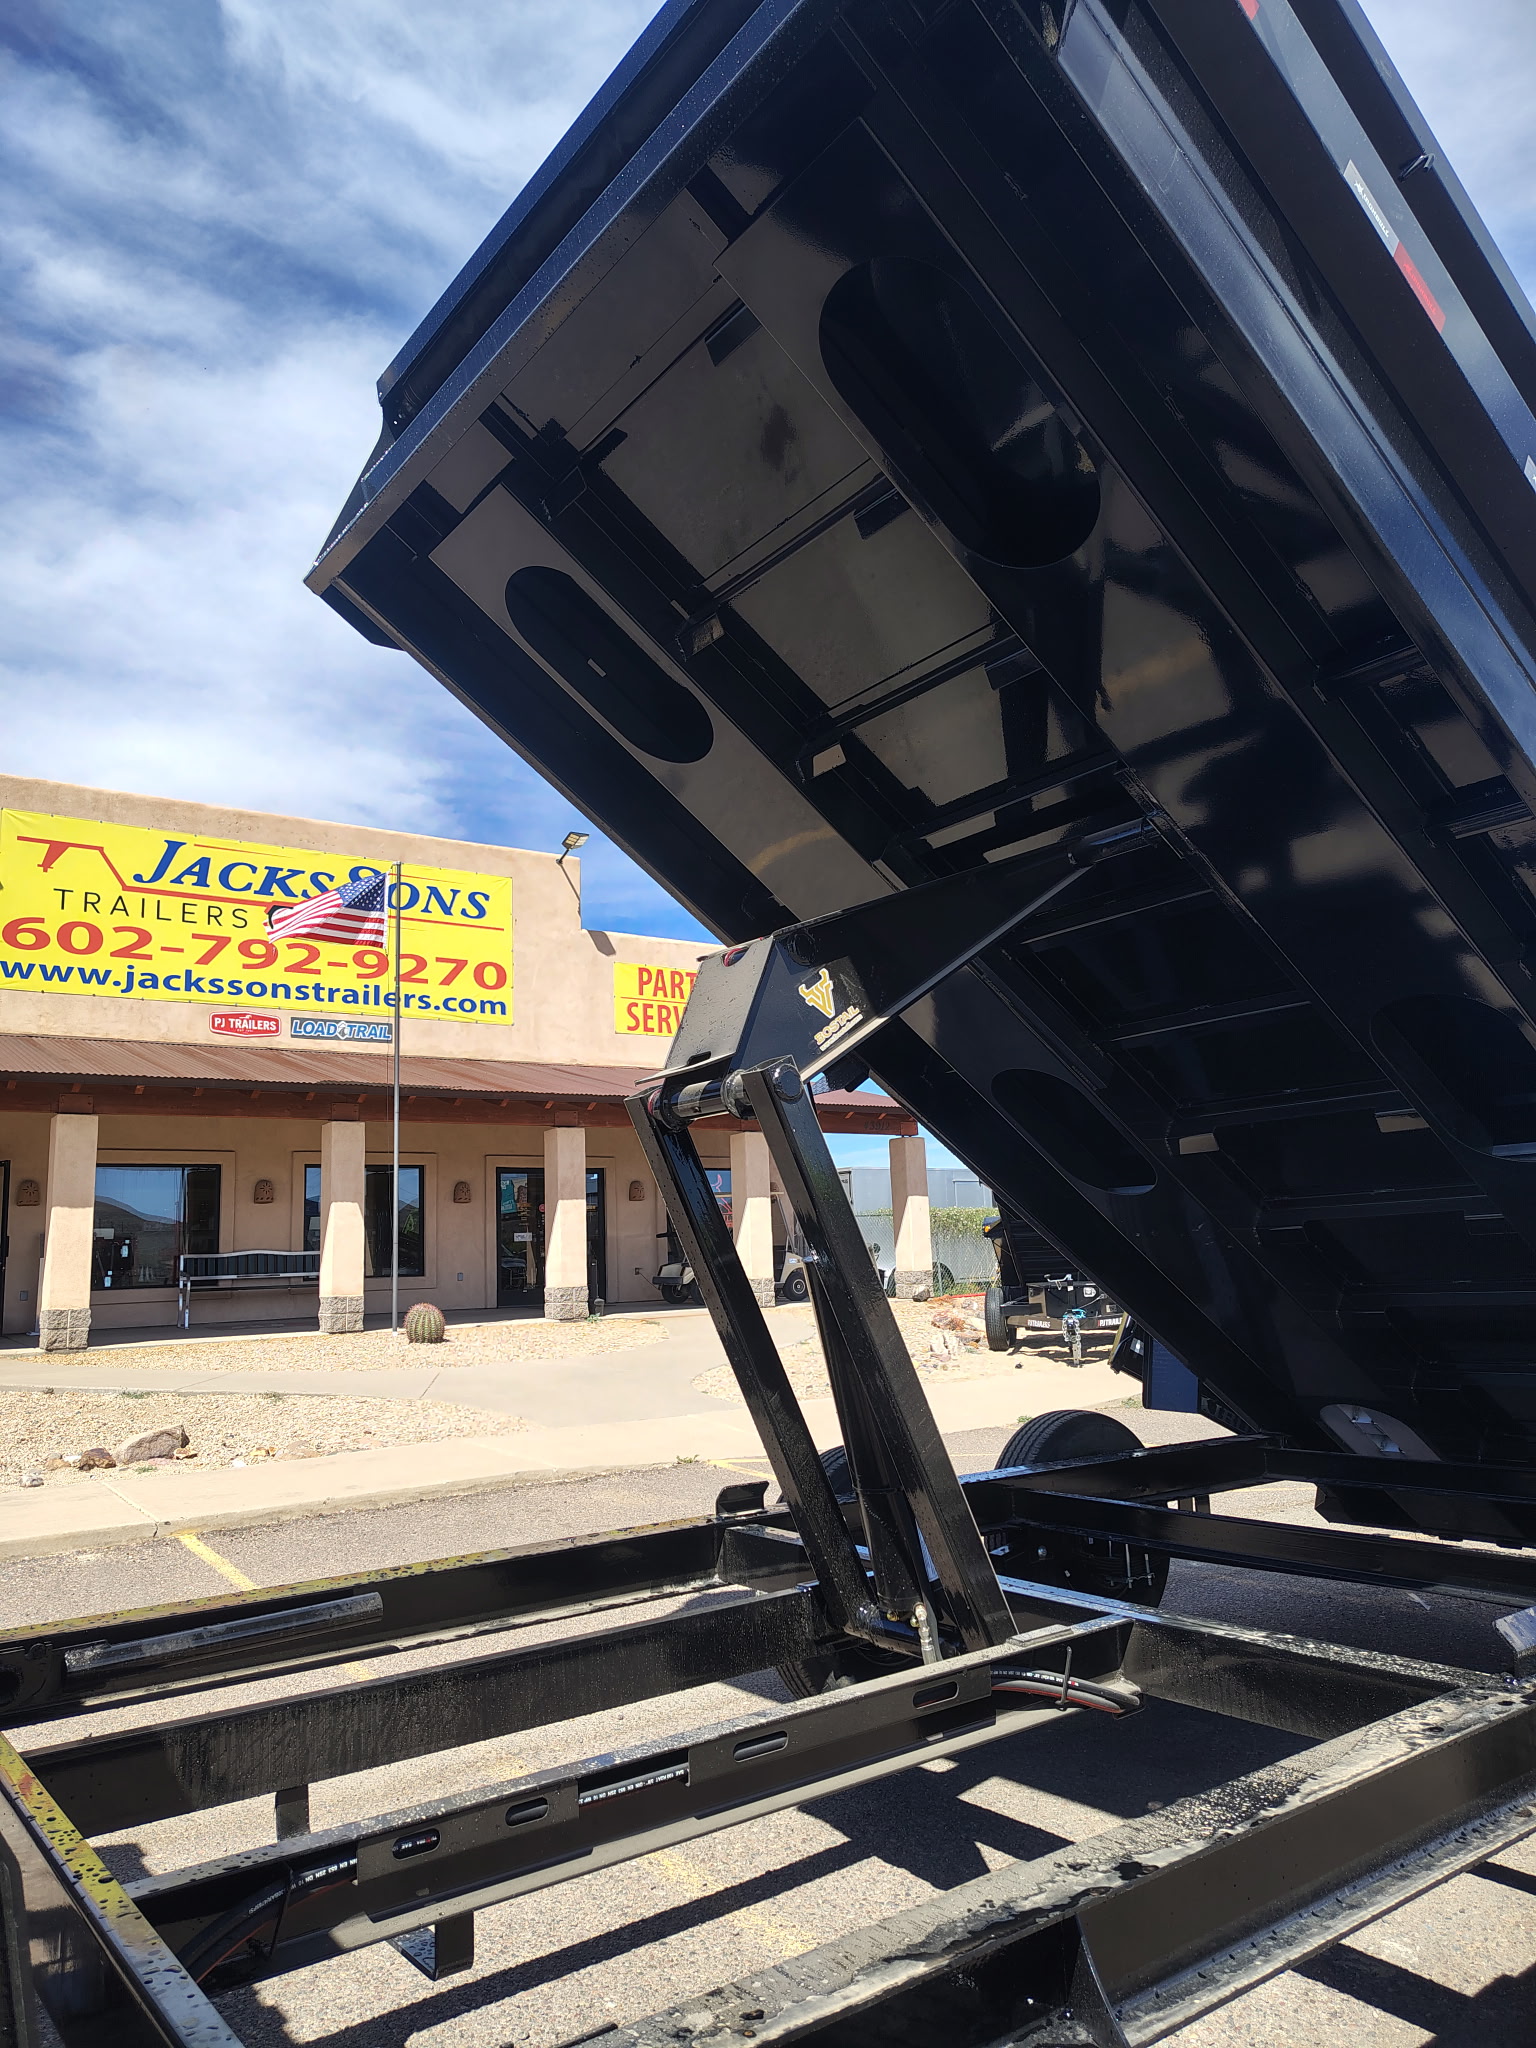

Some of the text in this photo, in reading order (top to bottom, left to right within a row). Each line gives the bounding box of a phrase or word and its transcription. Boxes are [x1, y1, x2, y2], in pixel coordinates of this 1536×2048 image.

[53, 888, 248, 929] TRAILERS
[1, 917, 507, 990] 602-792-9270
[0, 960, 507, 1016] www.jackssonstrailers.com
[214, 1017, 226, 1028] PJ
[228, 1018, 277, 1031] TRAILERS
[291, 1020, 392, 1041] LOAD TRAIL
